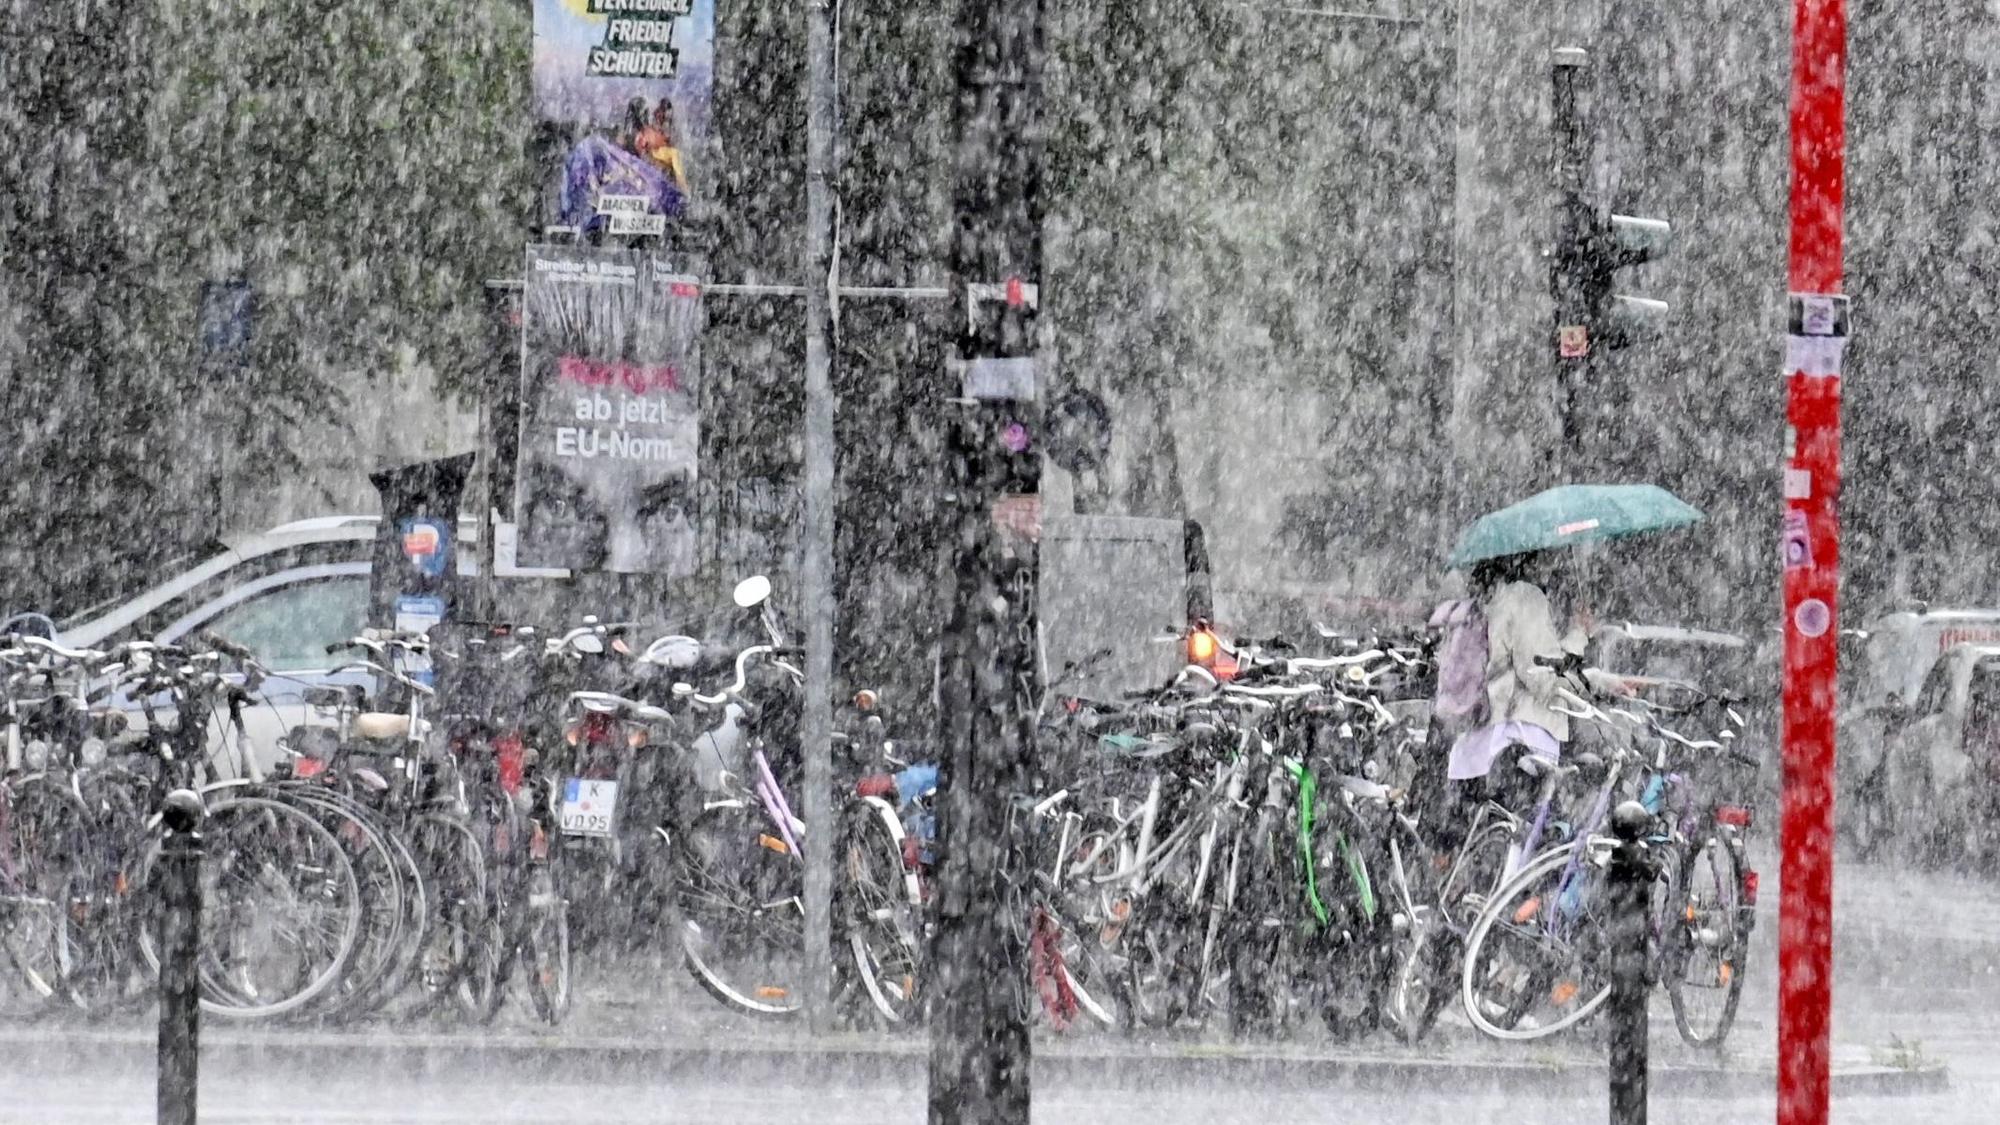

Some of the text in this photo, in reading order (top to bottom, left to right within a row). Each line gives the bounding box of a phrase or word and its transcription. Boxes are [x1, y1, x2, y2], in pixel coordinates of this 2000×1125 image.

[608, 18, 672, 43] FRIEDEN
[575, 394, 668, 428] ab jetzt
